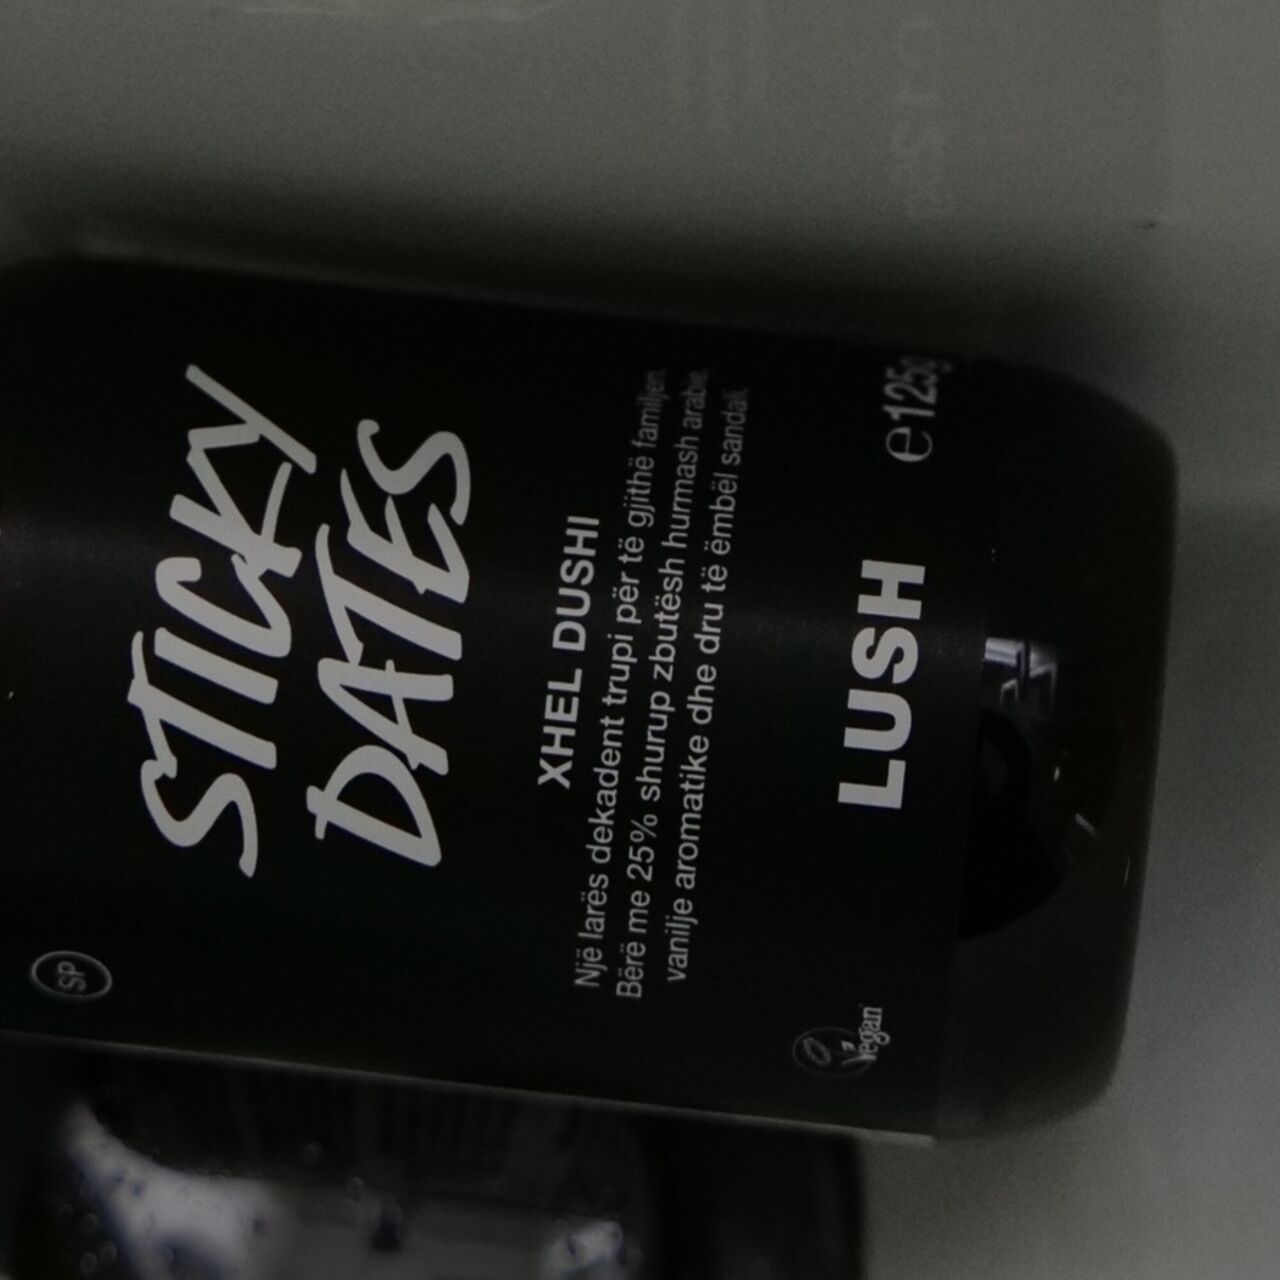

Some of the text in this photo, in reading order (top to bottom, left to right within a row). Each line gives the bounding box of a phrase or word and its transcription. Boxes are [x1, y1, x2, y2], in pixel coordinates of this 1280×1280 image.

[622, 455, 656, 528] gjithë
[661, 435, 700, 549] hurmash
[703, 472, 739, 556] ëmbël
[617, 535, 645, 564] të
[700, 564, 729, 593] të
[126, 364, 317, 878] STICKY
[611, 570, 643, 625] për
[647, 557, 686, 682] zbutësh
[693, 602, 725, 655] dru
[305, 419, 471, 867] DATES
[537, 515, 600, 789] XHEL DUSHI
[601, 632, 639, 707] trupi
[685, 663, 718, 726] dhe
[837, 559, 926, 809] LUSH
[634, 690, 676, 802] shurup
[585, 715, 625, 865] dekadent
[674, 734, 710, 890] aromatike
[625, 813, 659, 883] 25%
[577, 873, 610, 940] larës
[628, 889, 651, 934] me
[664, 897, 699, 982] vanilje
[56, 961, 87, 990] SP
[573, 946, 608, 987] Një
[615, 941, 647, 999] Bërë
[840, 1006, 891, 1065] Vegan
